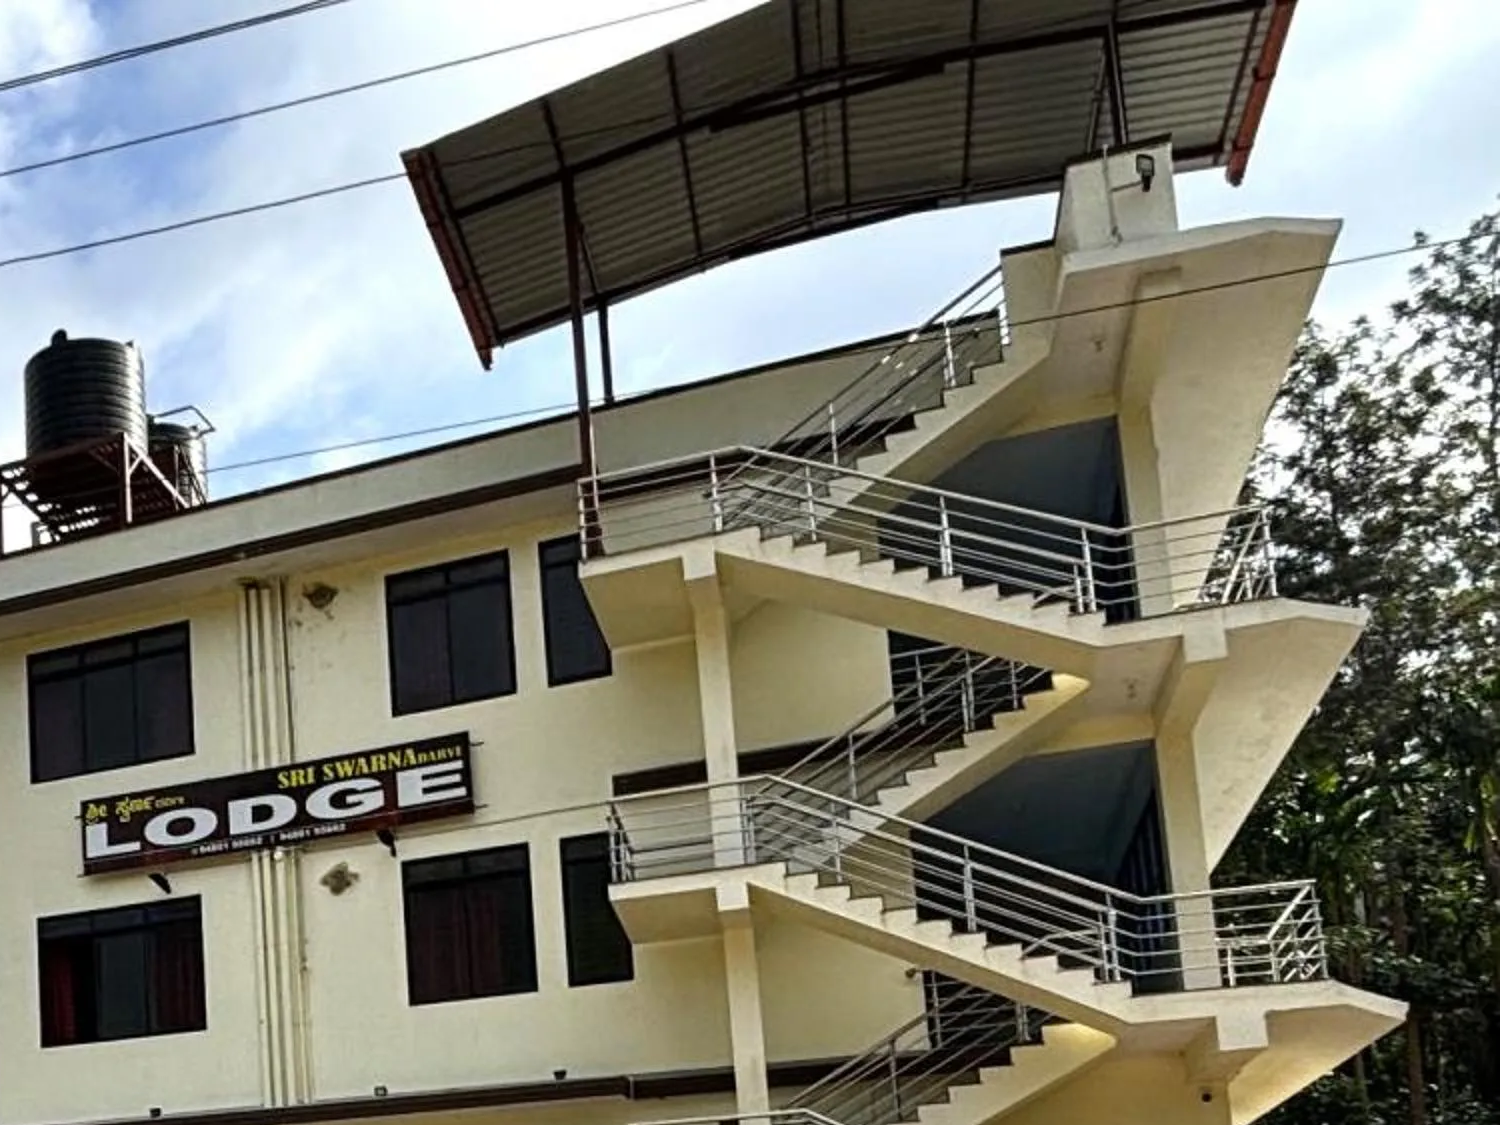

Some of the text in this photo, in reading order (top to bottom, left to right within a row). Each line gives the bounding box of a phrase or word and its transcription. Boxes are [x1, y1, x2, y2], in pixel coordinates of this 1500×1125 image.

[277, 768, 316, 789] SRI
[323, 747, 418, 781] SWARNA
[85, 759, 467, 859] LODGE
